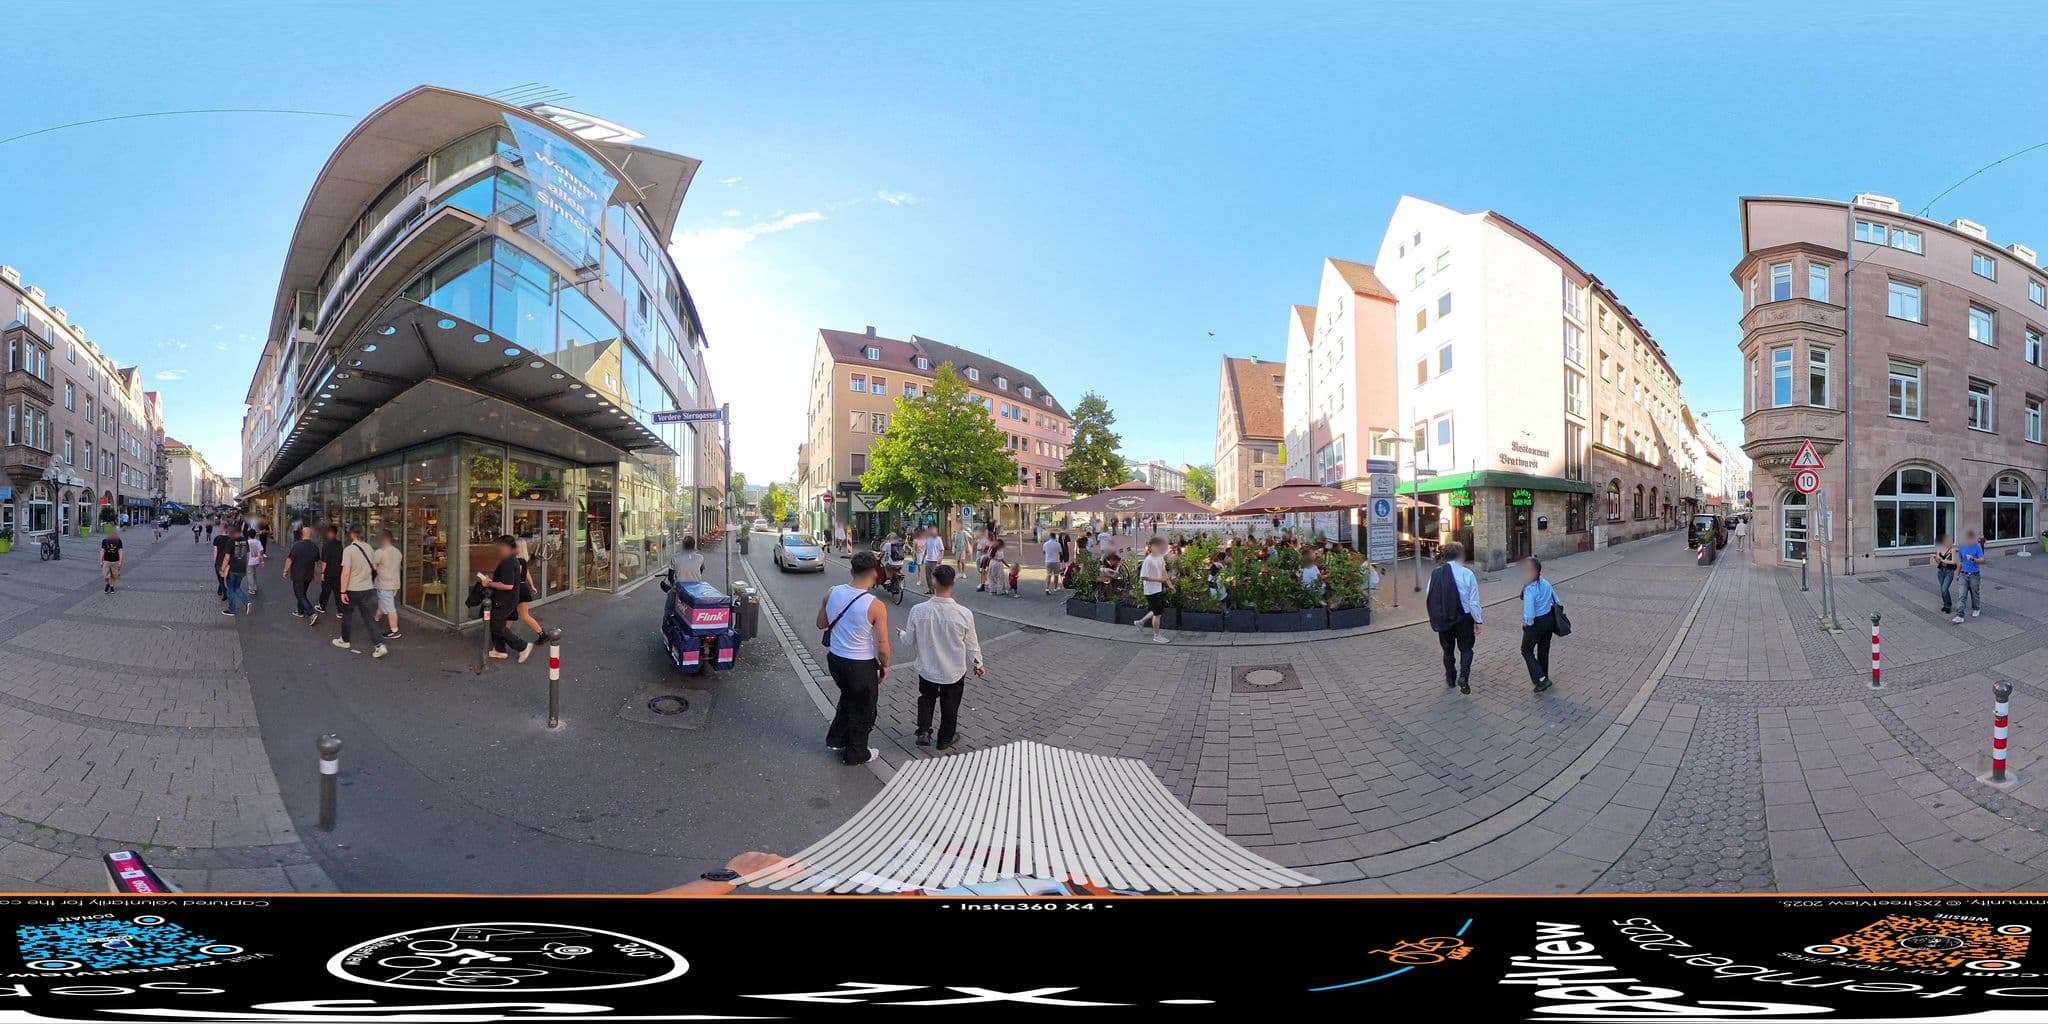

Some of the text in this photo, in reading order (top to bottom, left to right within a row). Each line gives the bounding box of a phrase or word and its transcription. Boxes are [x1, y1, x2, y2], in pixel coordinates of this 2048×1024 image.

[535, 151, 598, 200] Wohnen
[558, 176, 583, 200] mit
[547, 184, 585, 214] allen
[537, 191, 591, 239] Sinnen
[657, 413, 682, 422] Vordere
[1511, 440, 1550, 458] Restaurant
[1499, 453, 1539, 469] Bratwurst
[1801, 476, 1814, 487] 10
[378, 490, 399, 507] Erde
[696, 612, 724, 621] Flink
